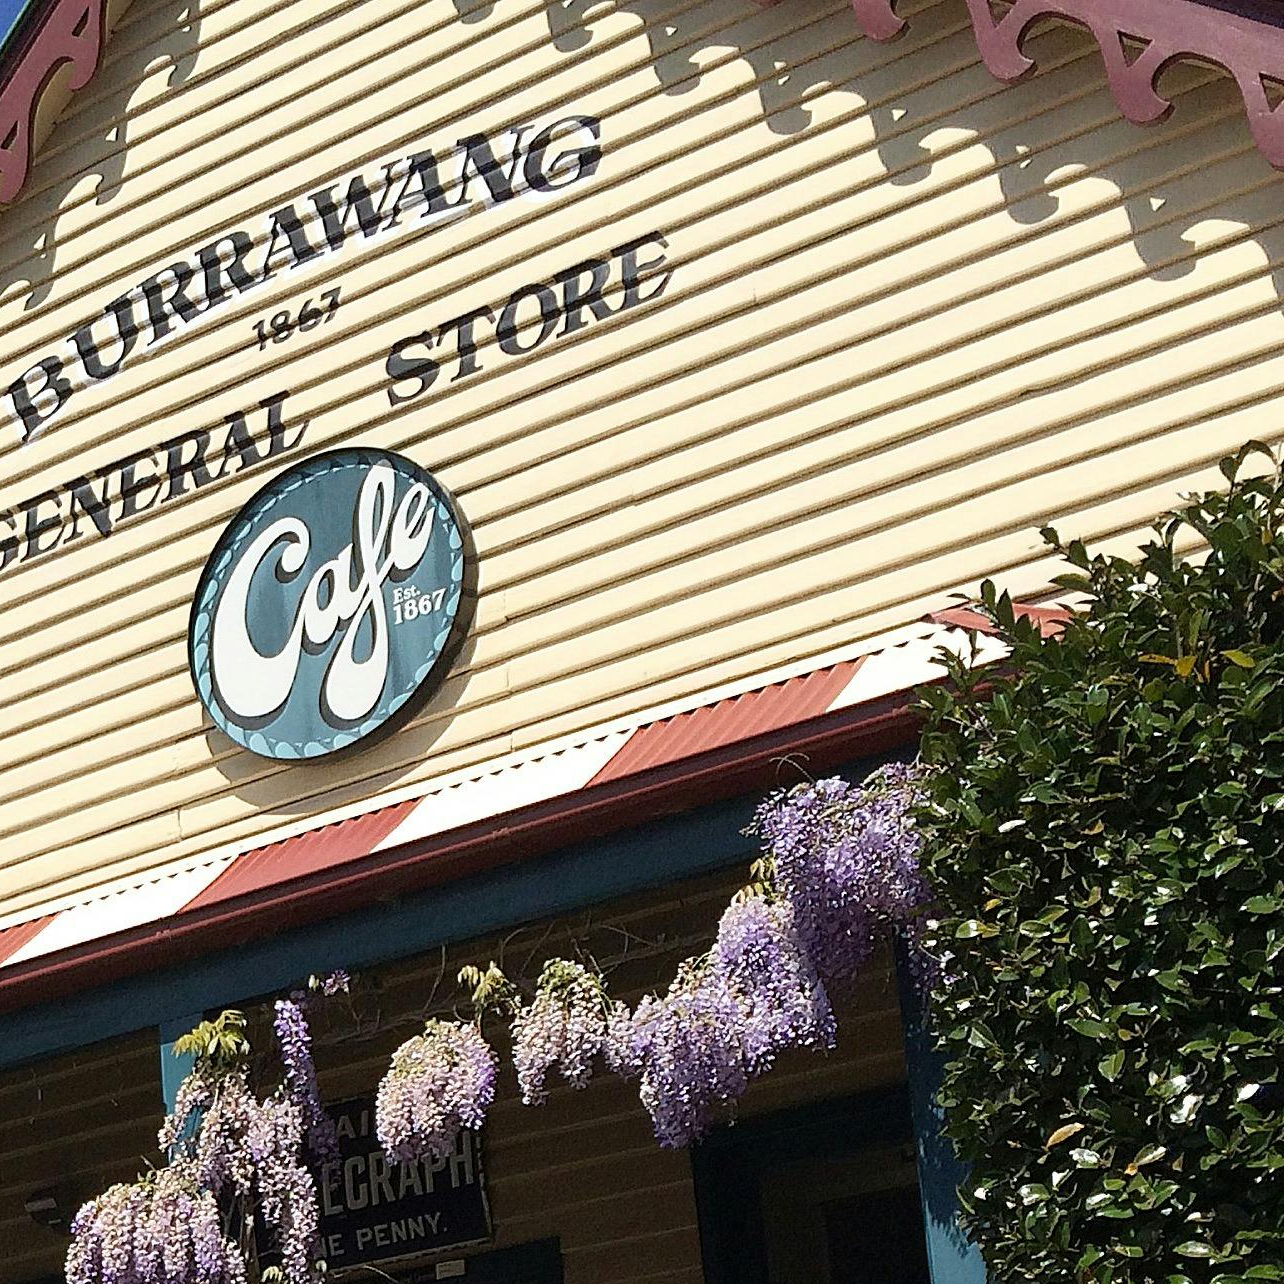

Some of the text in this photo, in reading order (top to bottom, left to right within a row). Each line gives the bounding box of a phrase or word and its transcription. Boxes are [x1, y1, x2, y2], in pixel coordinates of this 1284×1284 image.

[6, 114, 602, 442] BURRAWANG
[252, 287, 341, 352] 1867
[385, 230, 672, 407] STORE
[213, 459, 436, 721] Cafe
[392, 584, 421, 605] Est.
[393, 587, 447, 625] 1867
[322, 1129, 474, 1217] EGRAPH
